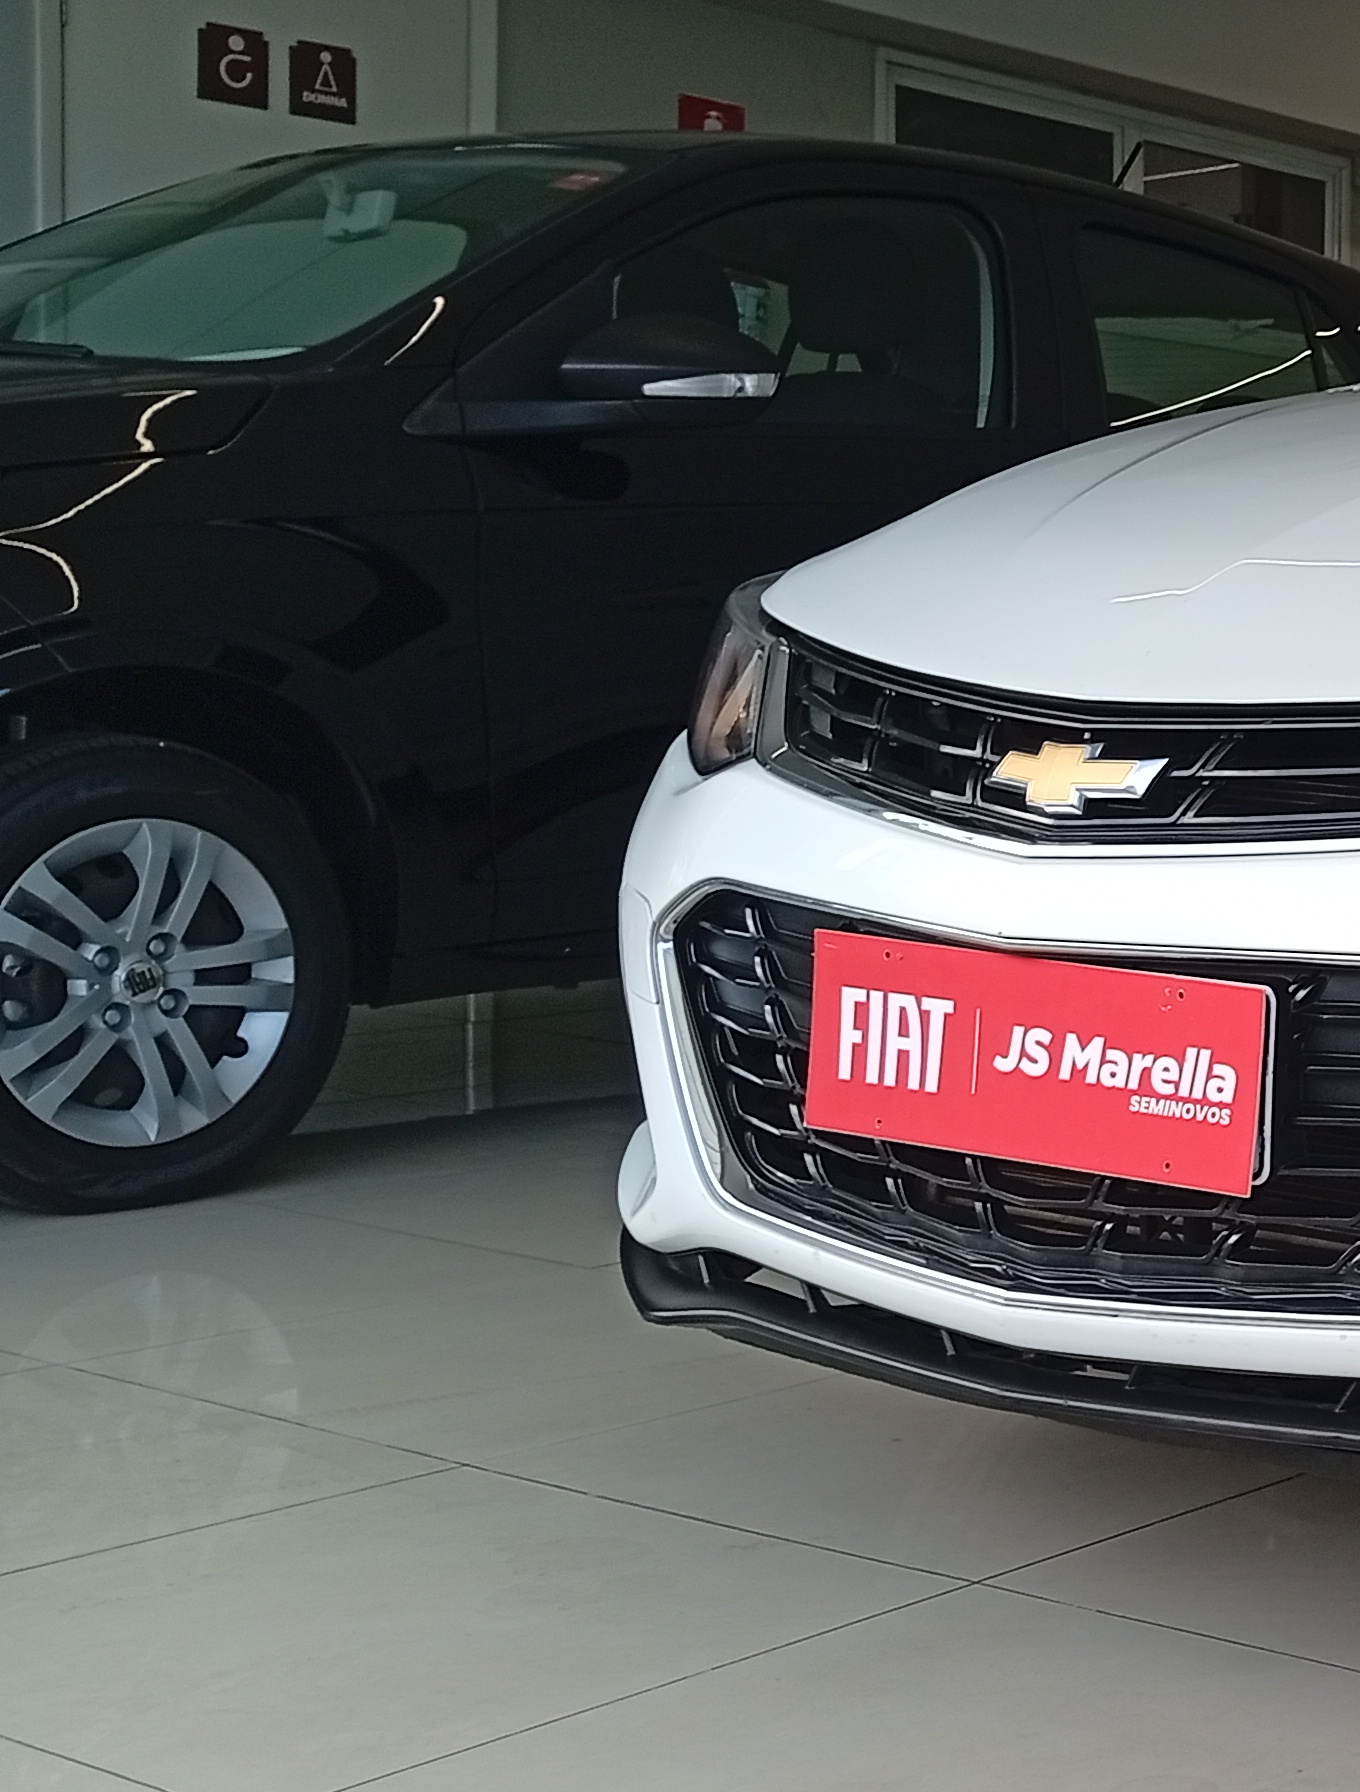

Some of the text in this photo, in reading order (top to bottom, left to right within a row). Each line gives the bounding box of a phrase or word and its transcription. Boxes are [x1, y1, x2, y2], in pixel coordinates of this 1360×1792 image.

[837, 985, 1238, 1104] FIAT JS Marella
[1128, 1095, 1233, 1126] SEMINOVOS
